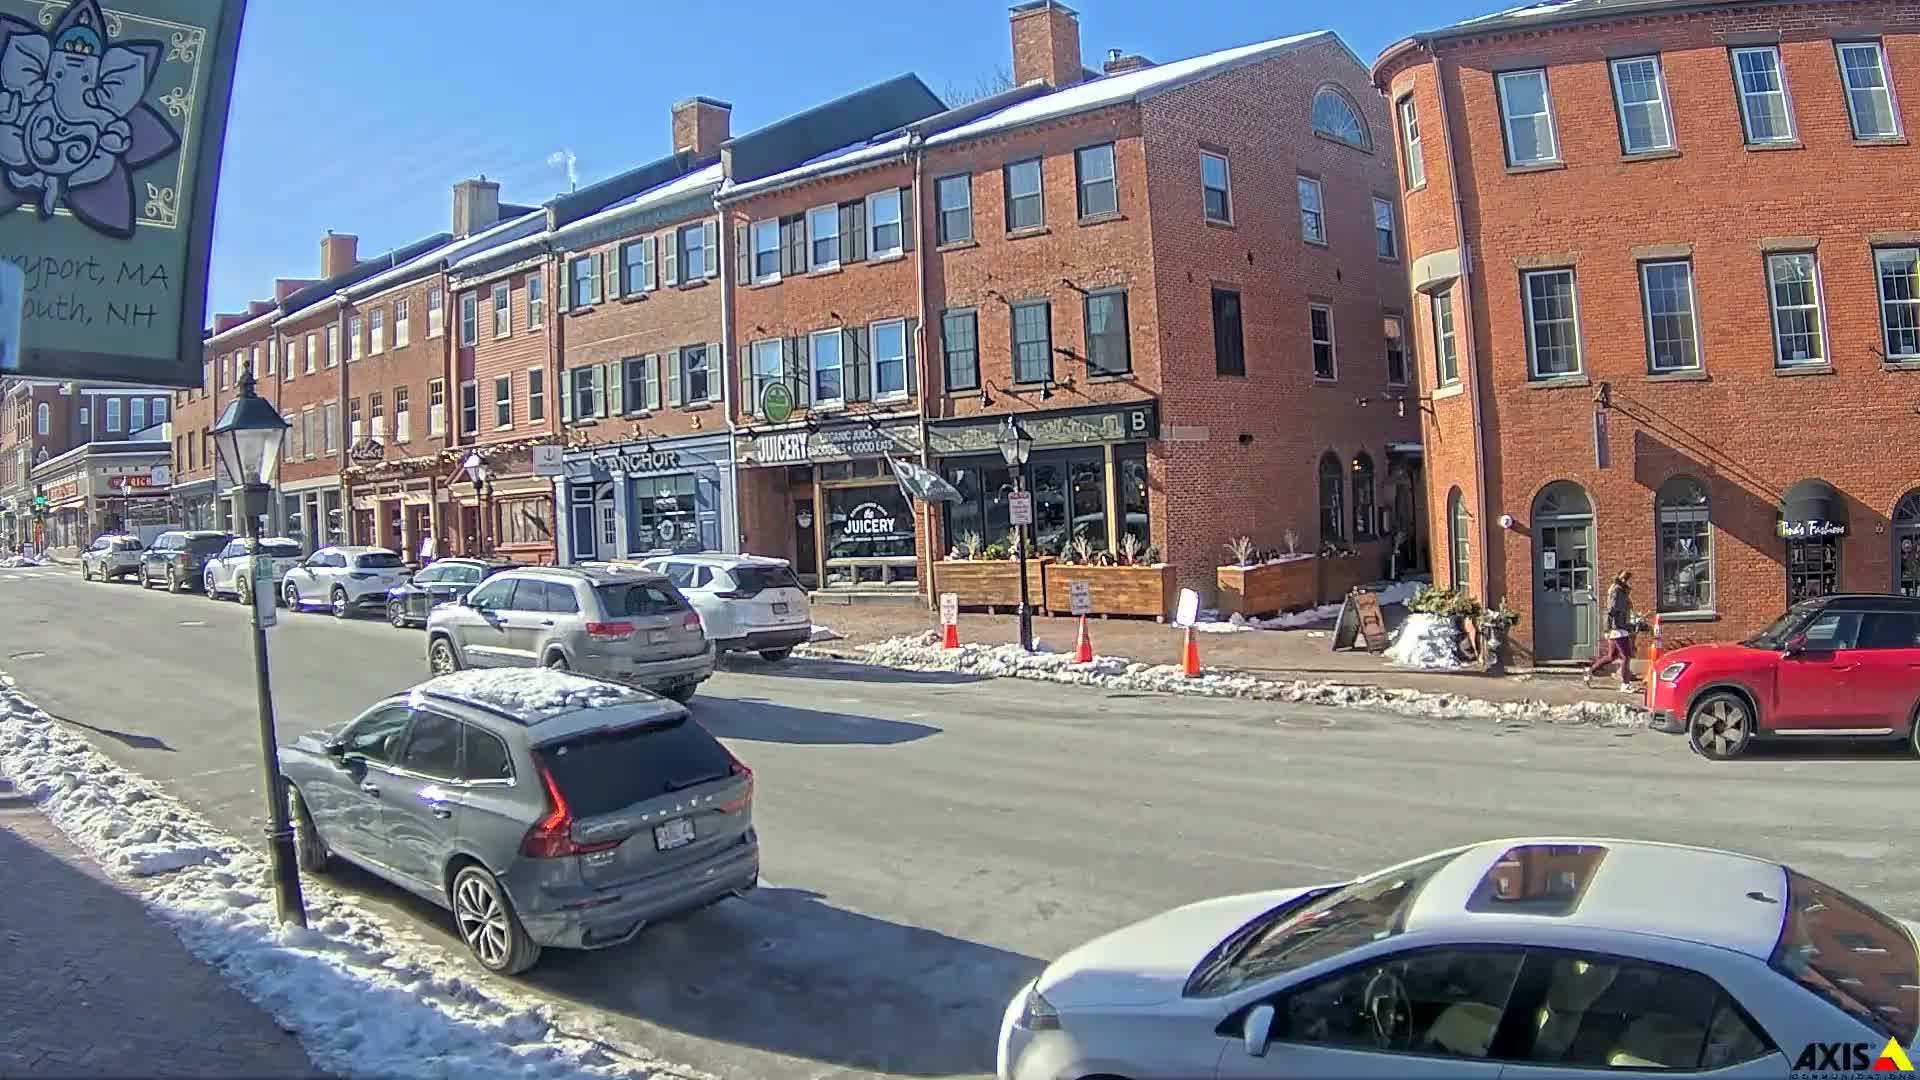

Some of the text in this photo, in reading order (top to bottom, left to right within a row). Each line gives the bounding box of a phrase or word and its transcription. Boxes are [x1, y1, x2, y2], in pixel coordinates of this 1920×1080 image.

[115, 260, 169, 290] MA
[106, 302, 160, 328] NH
[1131, 410, 1146, 431] B
[757, 432, 809, 462] JUICERY
[852, 440, 875, 454] GOOD
[875, 439, 894, 451] EATS
[607, 450, 678, 472] ANCHOR
[843, 517, 896, 534] JUICERY
